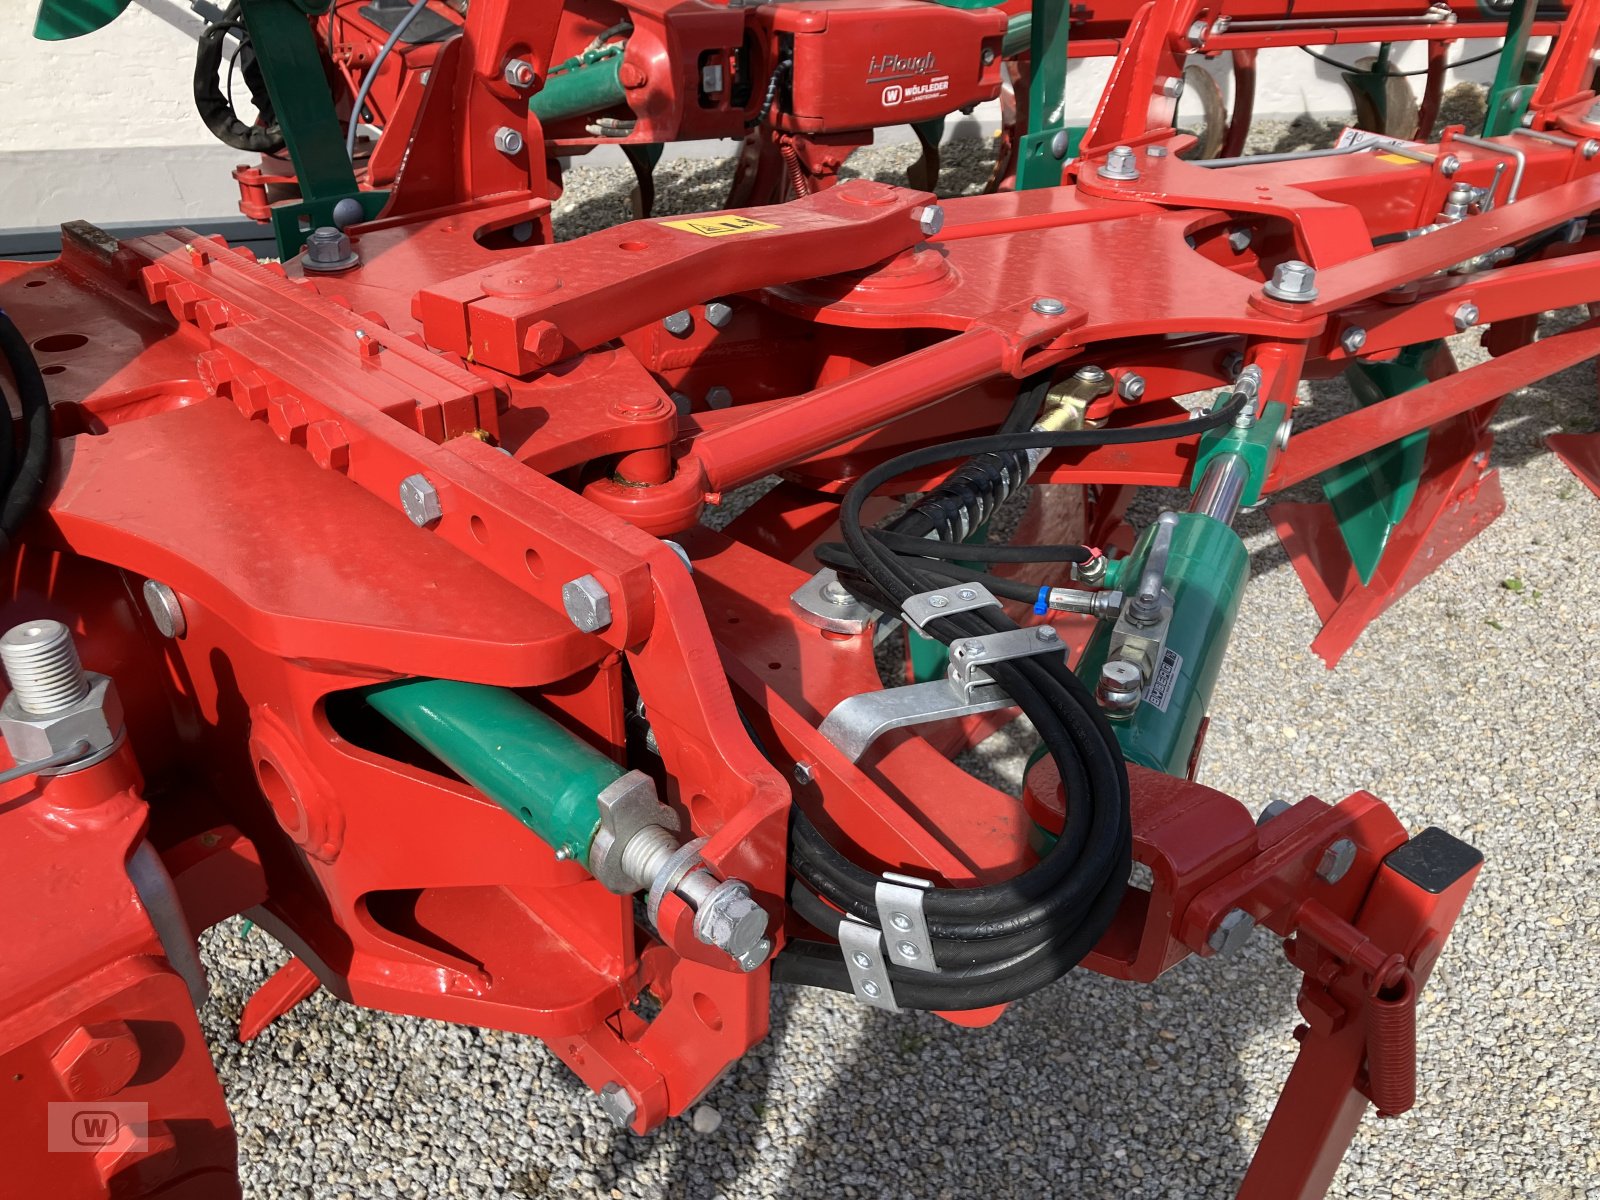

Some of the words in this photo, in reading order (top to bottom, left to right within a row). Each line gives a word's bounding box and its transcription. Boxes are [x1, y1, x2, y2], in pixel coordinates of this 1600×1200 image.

[868, 52, 935, 74] i-Plough
[904, 82, 949, 97] WÖLFLEDER
[1148, 662, 1173, 707] BYBERG
